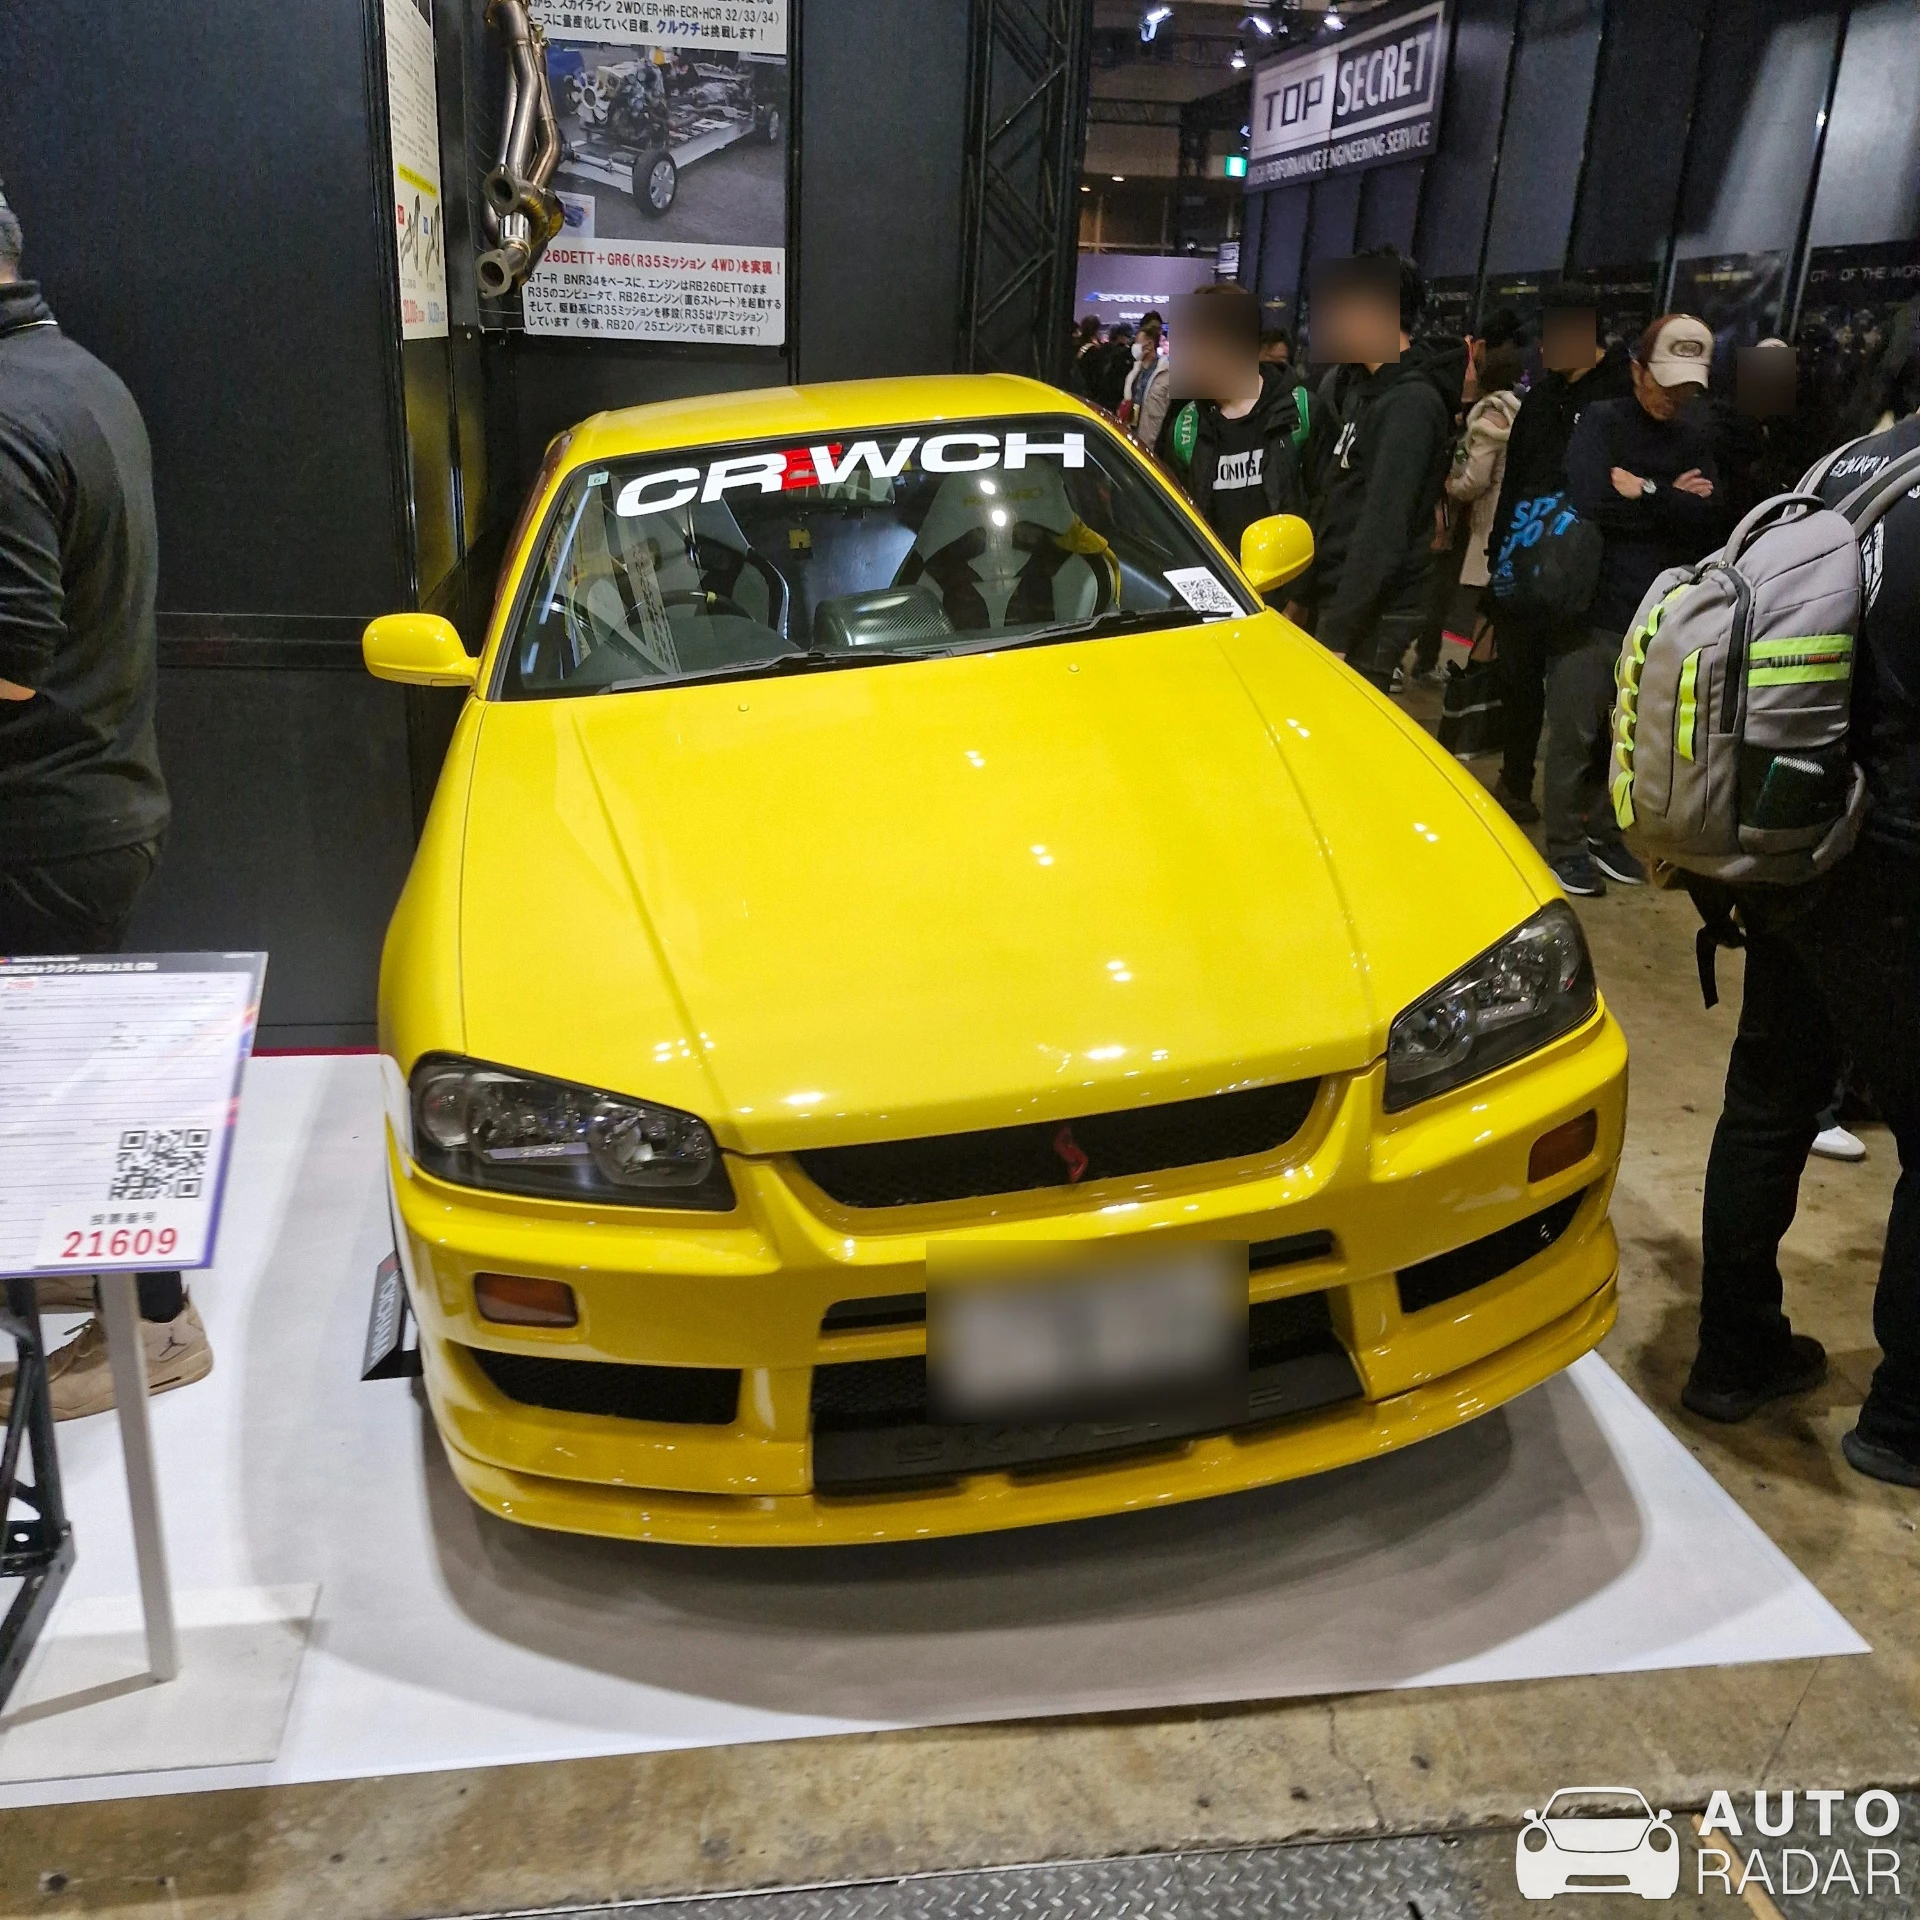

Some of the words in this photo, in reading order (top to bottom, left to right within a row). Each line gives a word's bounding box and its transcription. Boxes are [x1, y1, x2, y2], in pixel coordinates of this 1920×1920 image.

[530, 0, 612, 12] がら、スカイライン
[725, 8, 779, 24] 32/33/34)
[1264, 74, 1324, 131] TOP
[1336, 31, 1432, 116] SECRET
[1386, 121, 1431, 154] SERVICE
[1098, 293, 1153, 303] SPORTS
[61, 1227, 177, 1258] 21609
